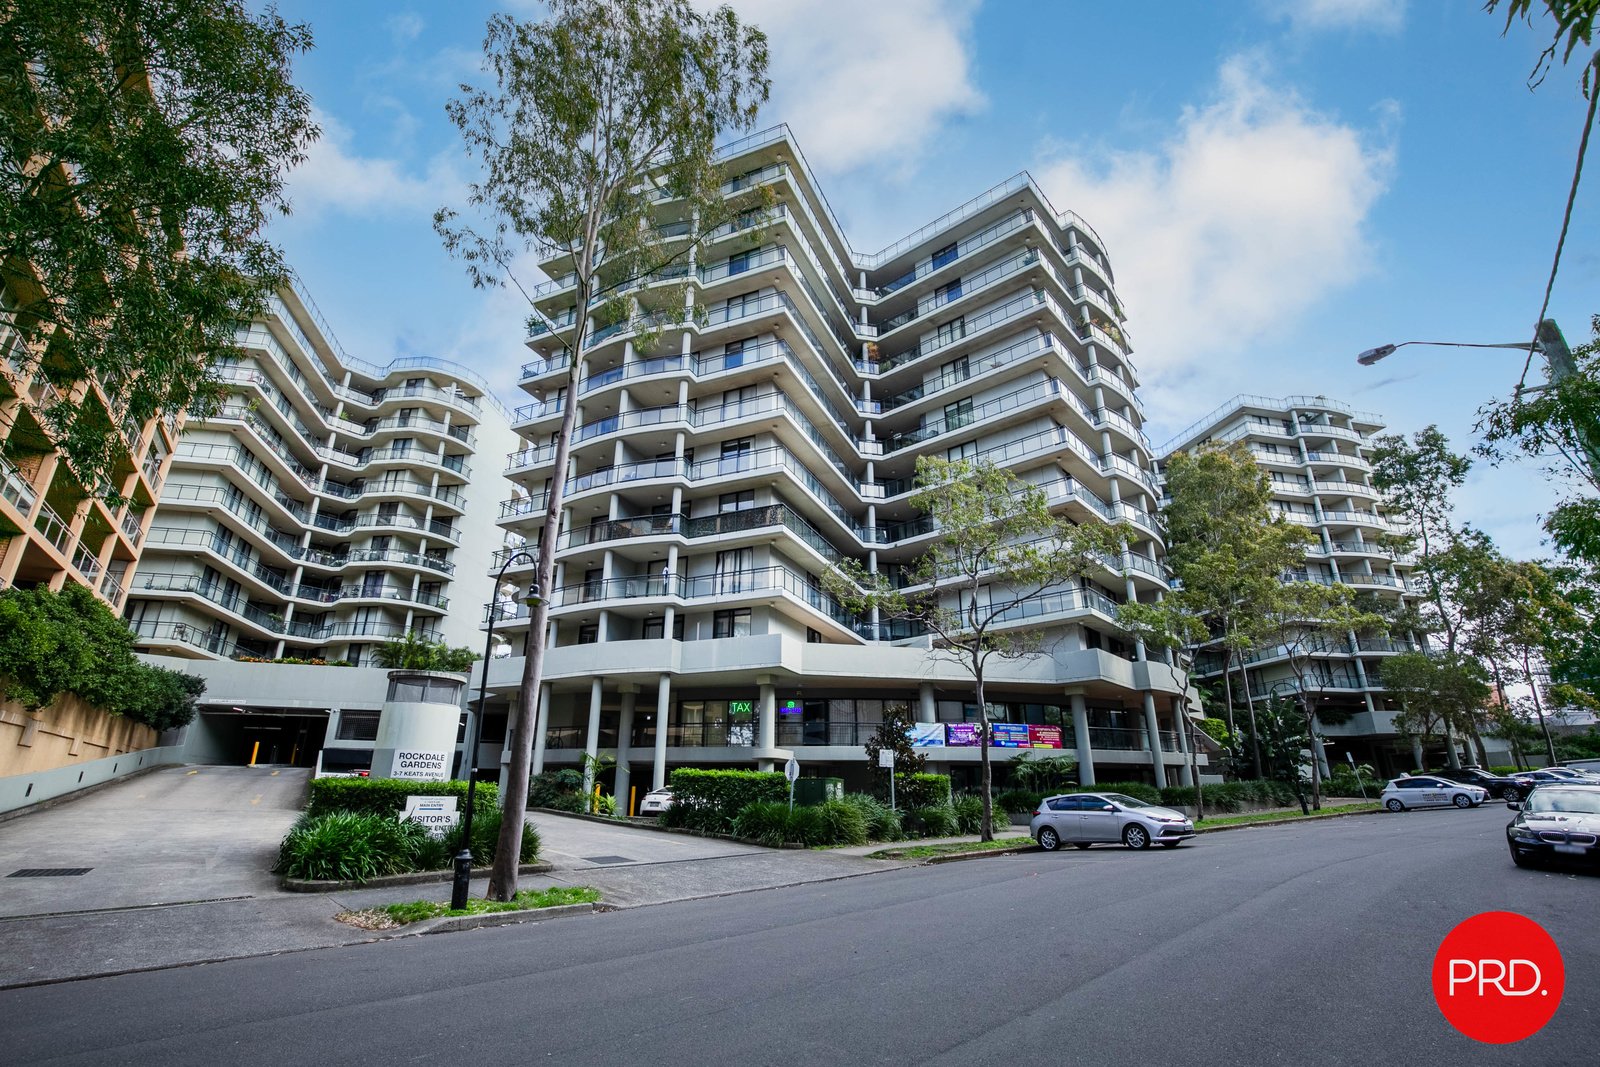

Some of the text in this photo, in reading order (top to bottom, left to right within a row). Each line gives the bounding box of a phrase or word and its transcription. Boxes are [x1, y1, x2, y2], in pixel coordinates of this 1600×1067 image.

[732, 702, 751, 712] TAX
[398, 752, 445, 761] ROCKDALE
[400, 761, 442, 769] GARDENS
